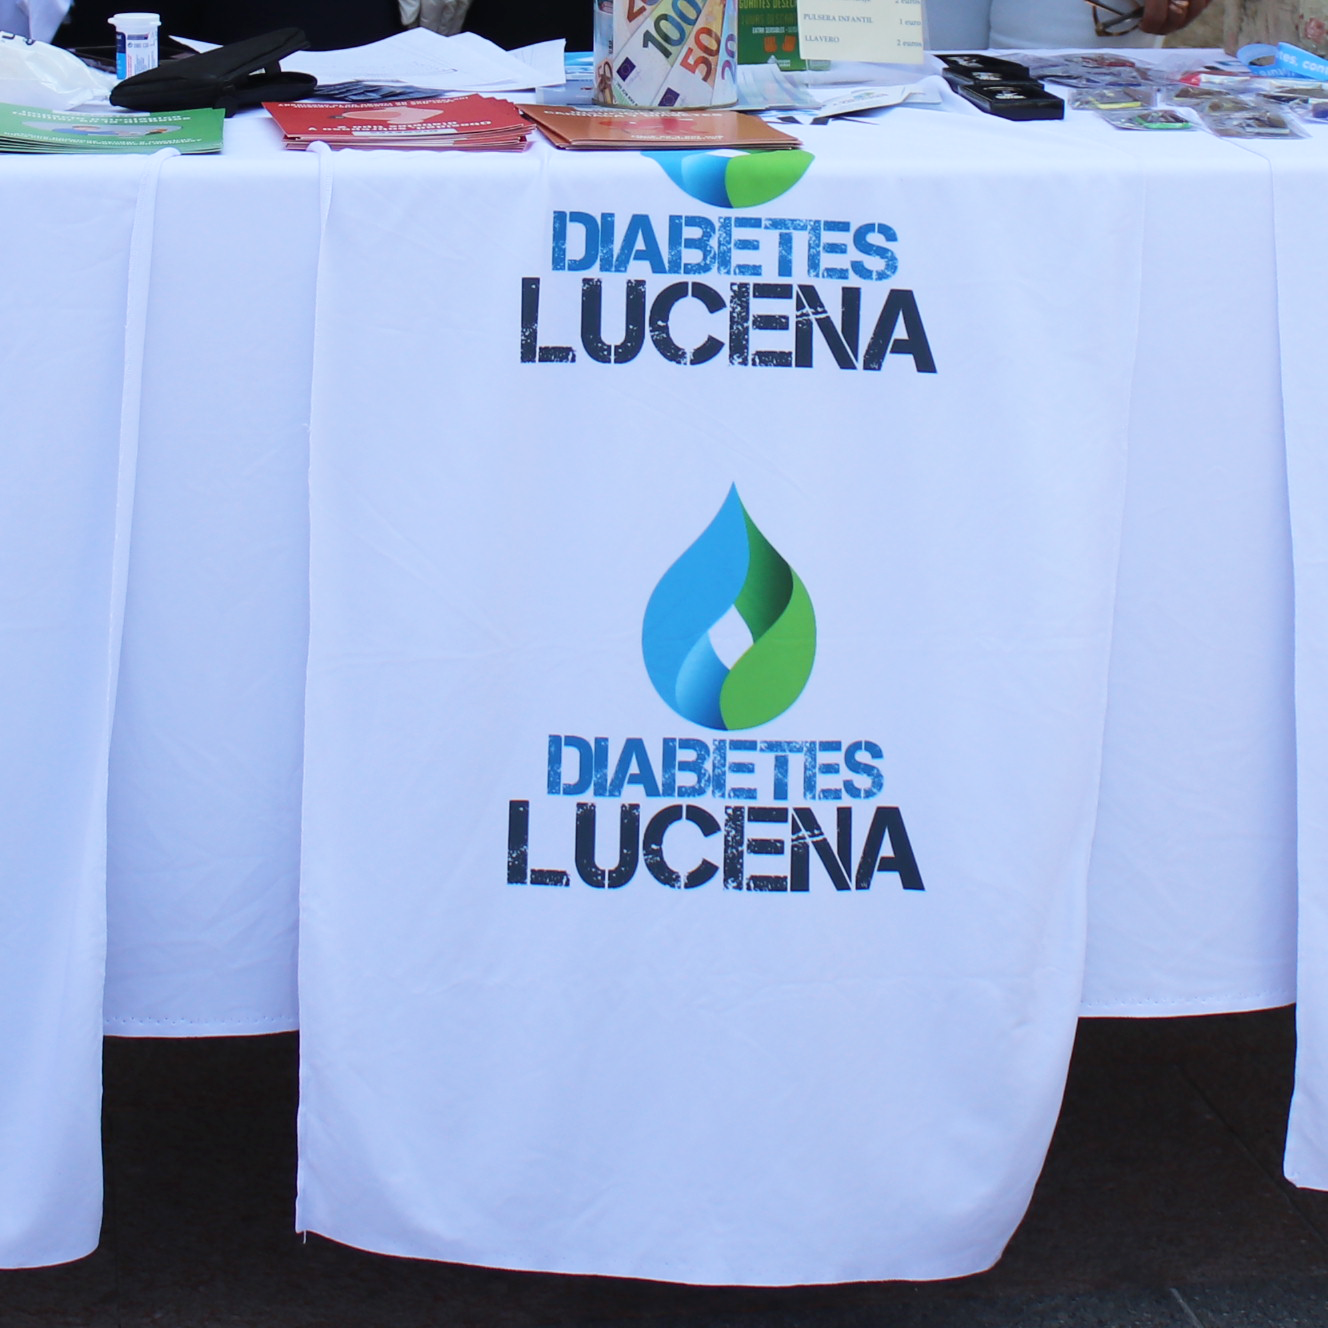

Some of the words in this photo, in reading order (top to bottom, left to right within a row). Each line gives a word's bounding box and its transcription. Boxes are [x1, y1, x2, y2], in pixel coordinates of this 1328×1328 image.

[803, 13, 836, 22] PULSERA
[805, 35, 840, 43] LLAVERO
[679, 26, 721, 83] 50
[552, 210, 899, 281] DIABETES
[520, 277, 938, 374] LUCENA
[547, 734, 884, 801] DIABETES
[507, 800, 926, 892] LUCENA
